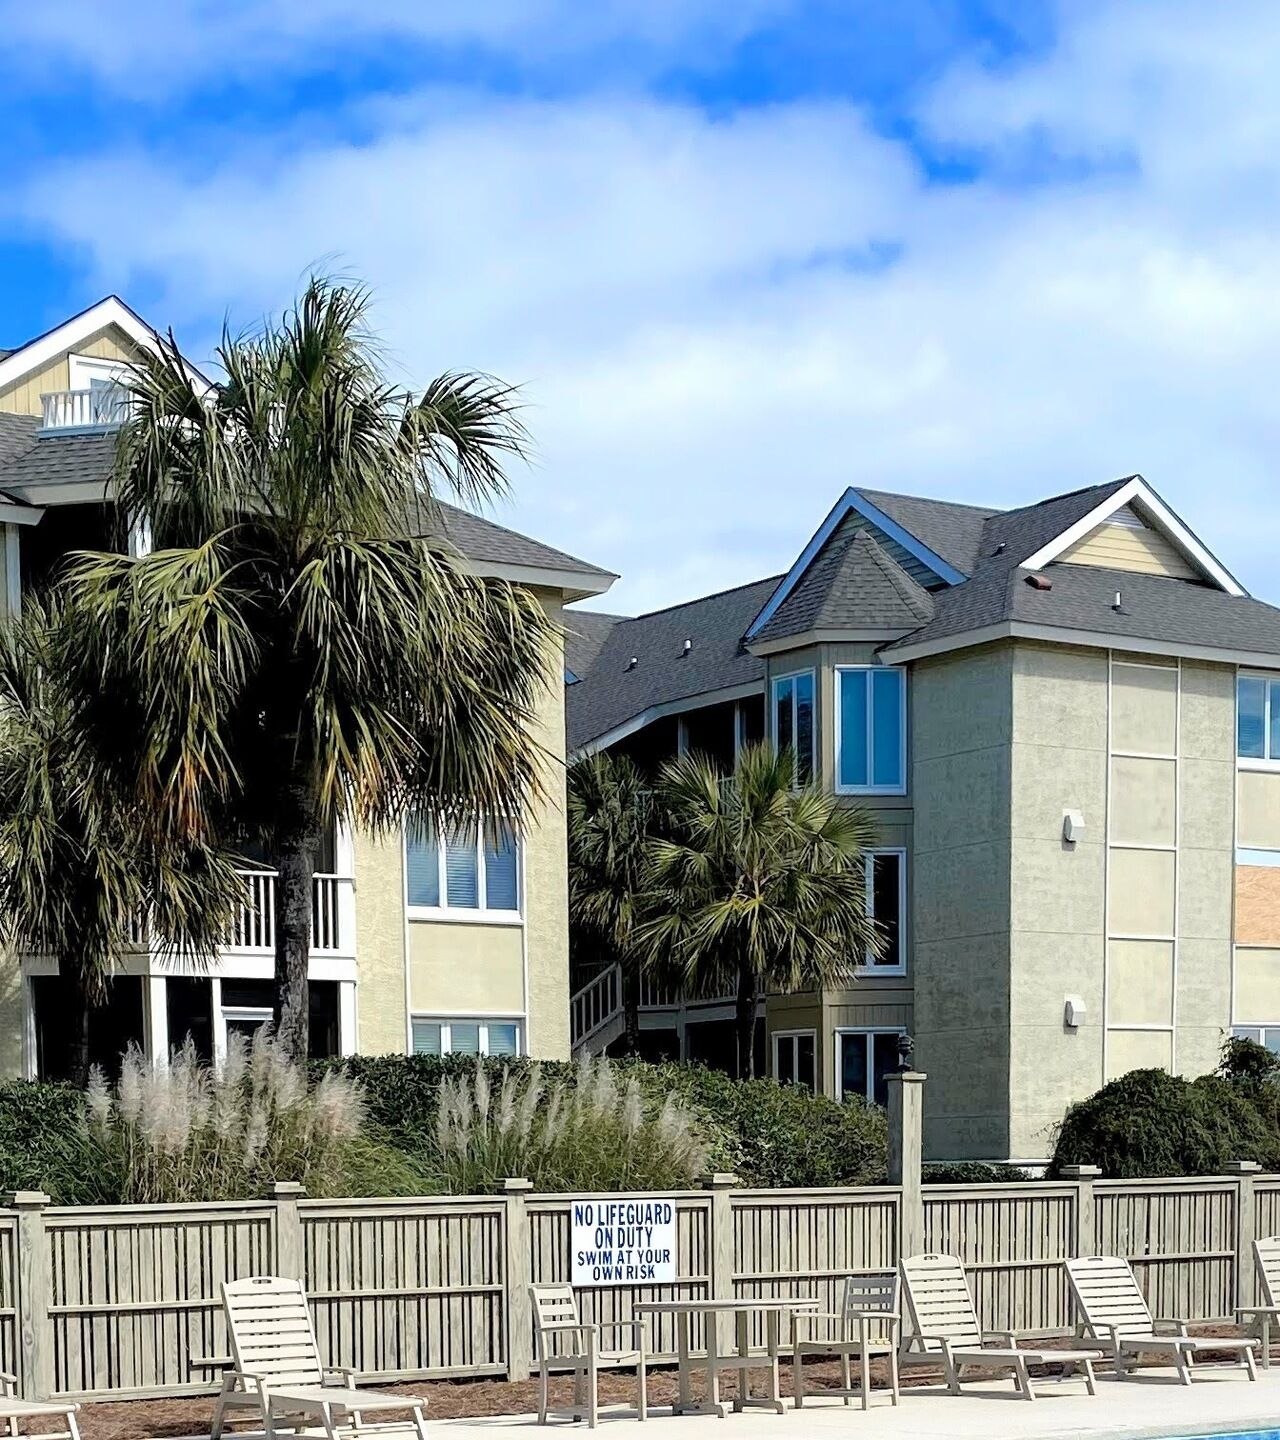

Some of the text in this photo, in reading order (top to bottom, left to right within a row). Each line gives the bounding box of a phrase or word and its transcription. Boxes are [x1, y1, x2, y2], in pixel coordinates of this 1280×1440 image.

[575, 1203, 672, 1227] NO LIFEGUARD
[595, 1226, 653, 1249] ON DUTY
[577, 1249, 670, 1266] SWIM AT YOUR
[593, 1264, 655, 1281] OWN RISK
